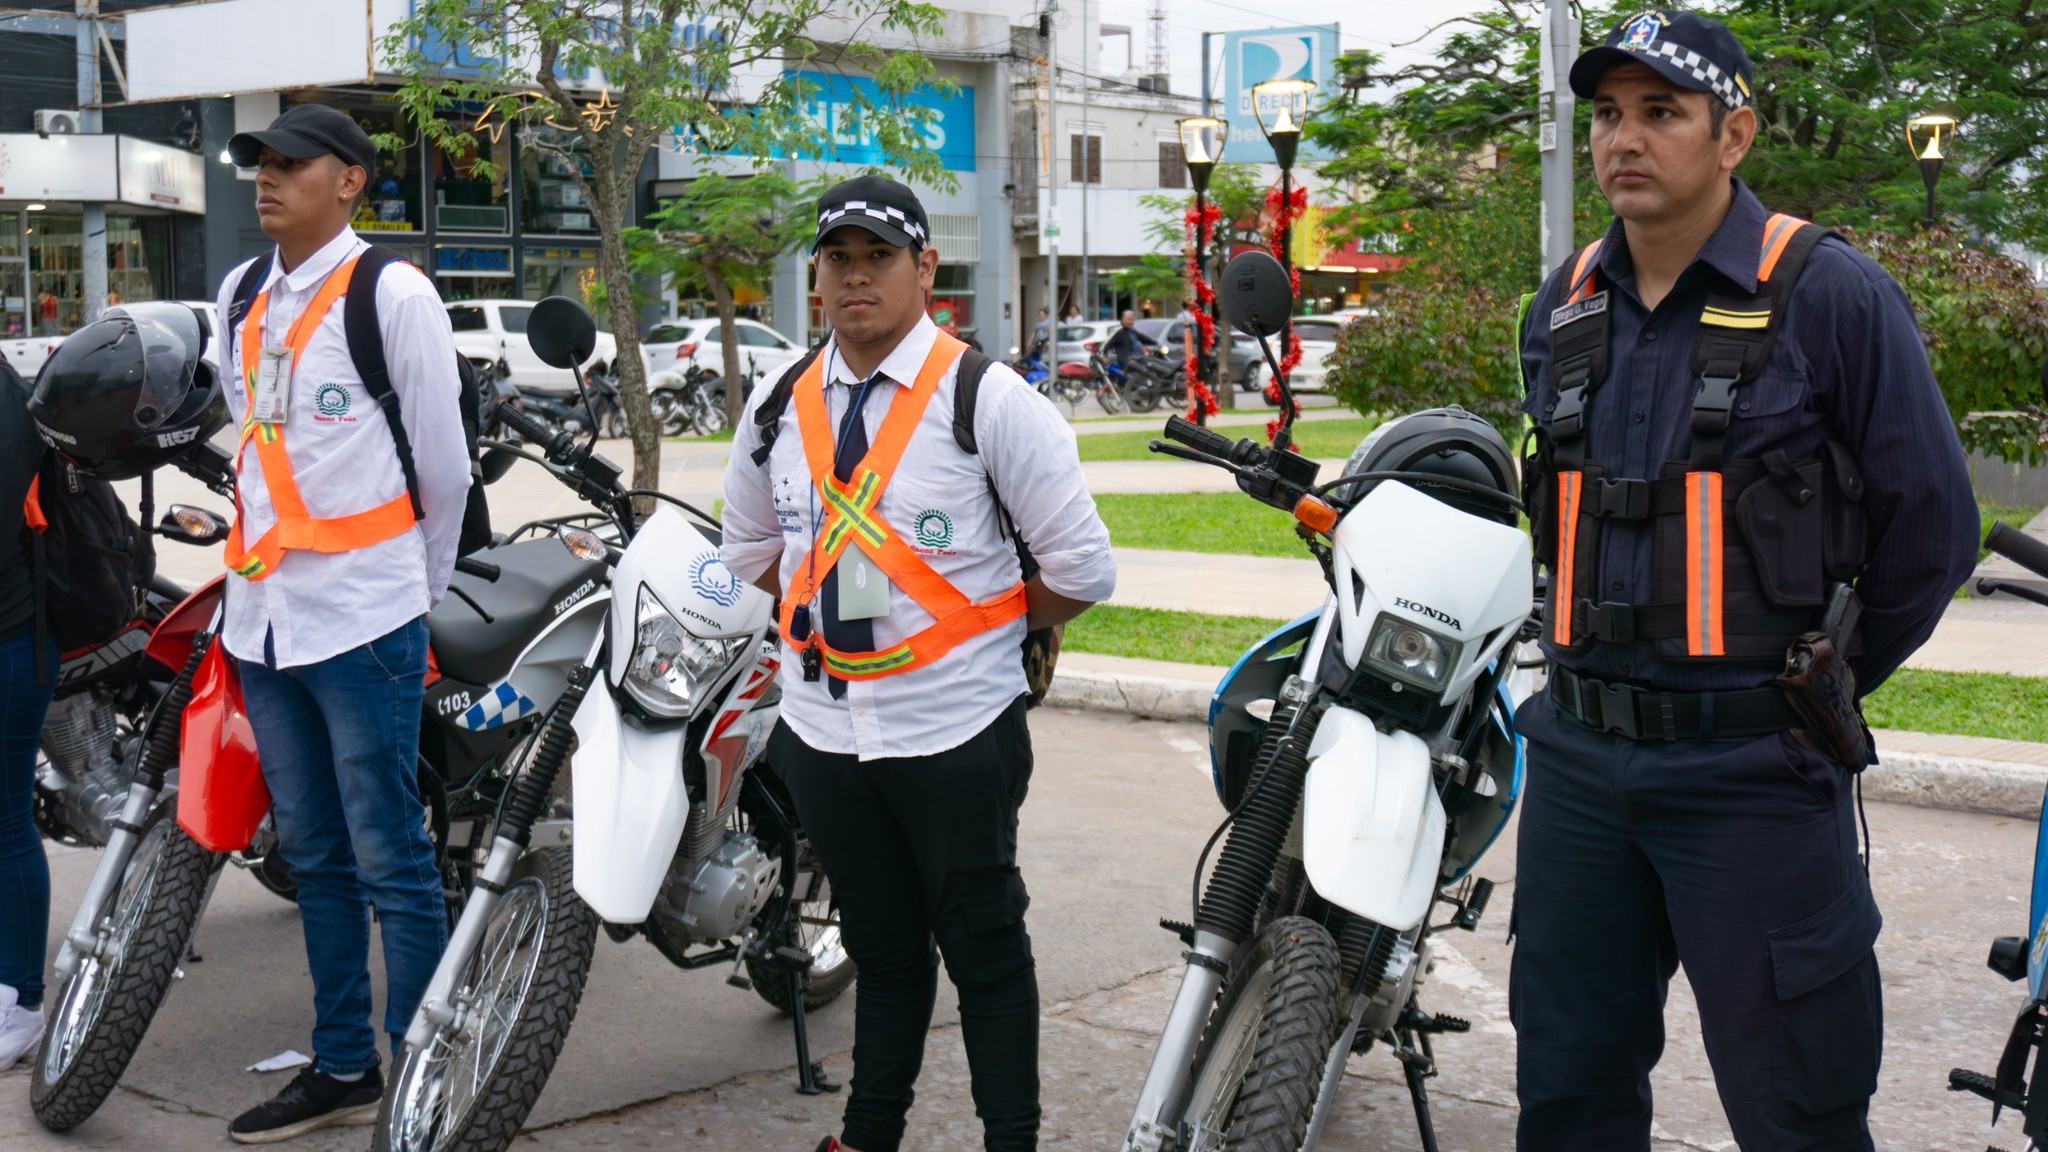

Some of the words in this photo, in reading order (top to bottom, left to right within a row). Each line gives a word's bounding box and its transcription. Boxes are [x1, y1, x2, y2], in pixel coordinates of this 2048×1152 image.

[1241, 92, 1314, 110] DRECTV
[157, 426, 200, 448] H57
[554, 578, 596, 616] HONDA
[681, 606, 723, 631] HONDA
[1393, 596, 1462, 632] HONDA
